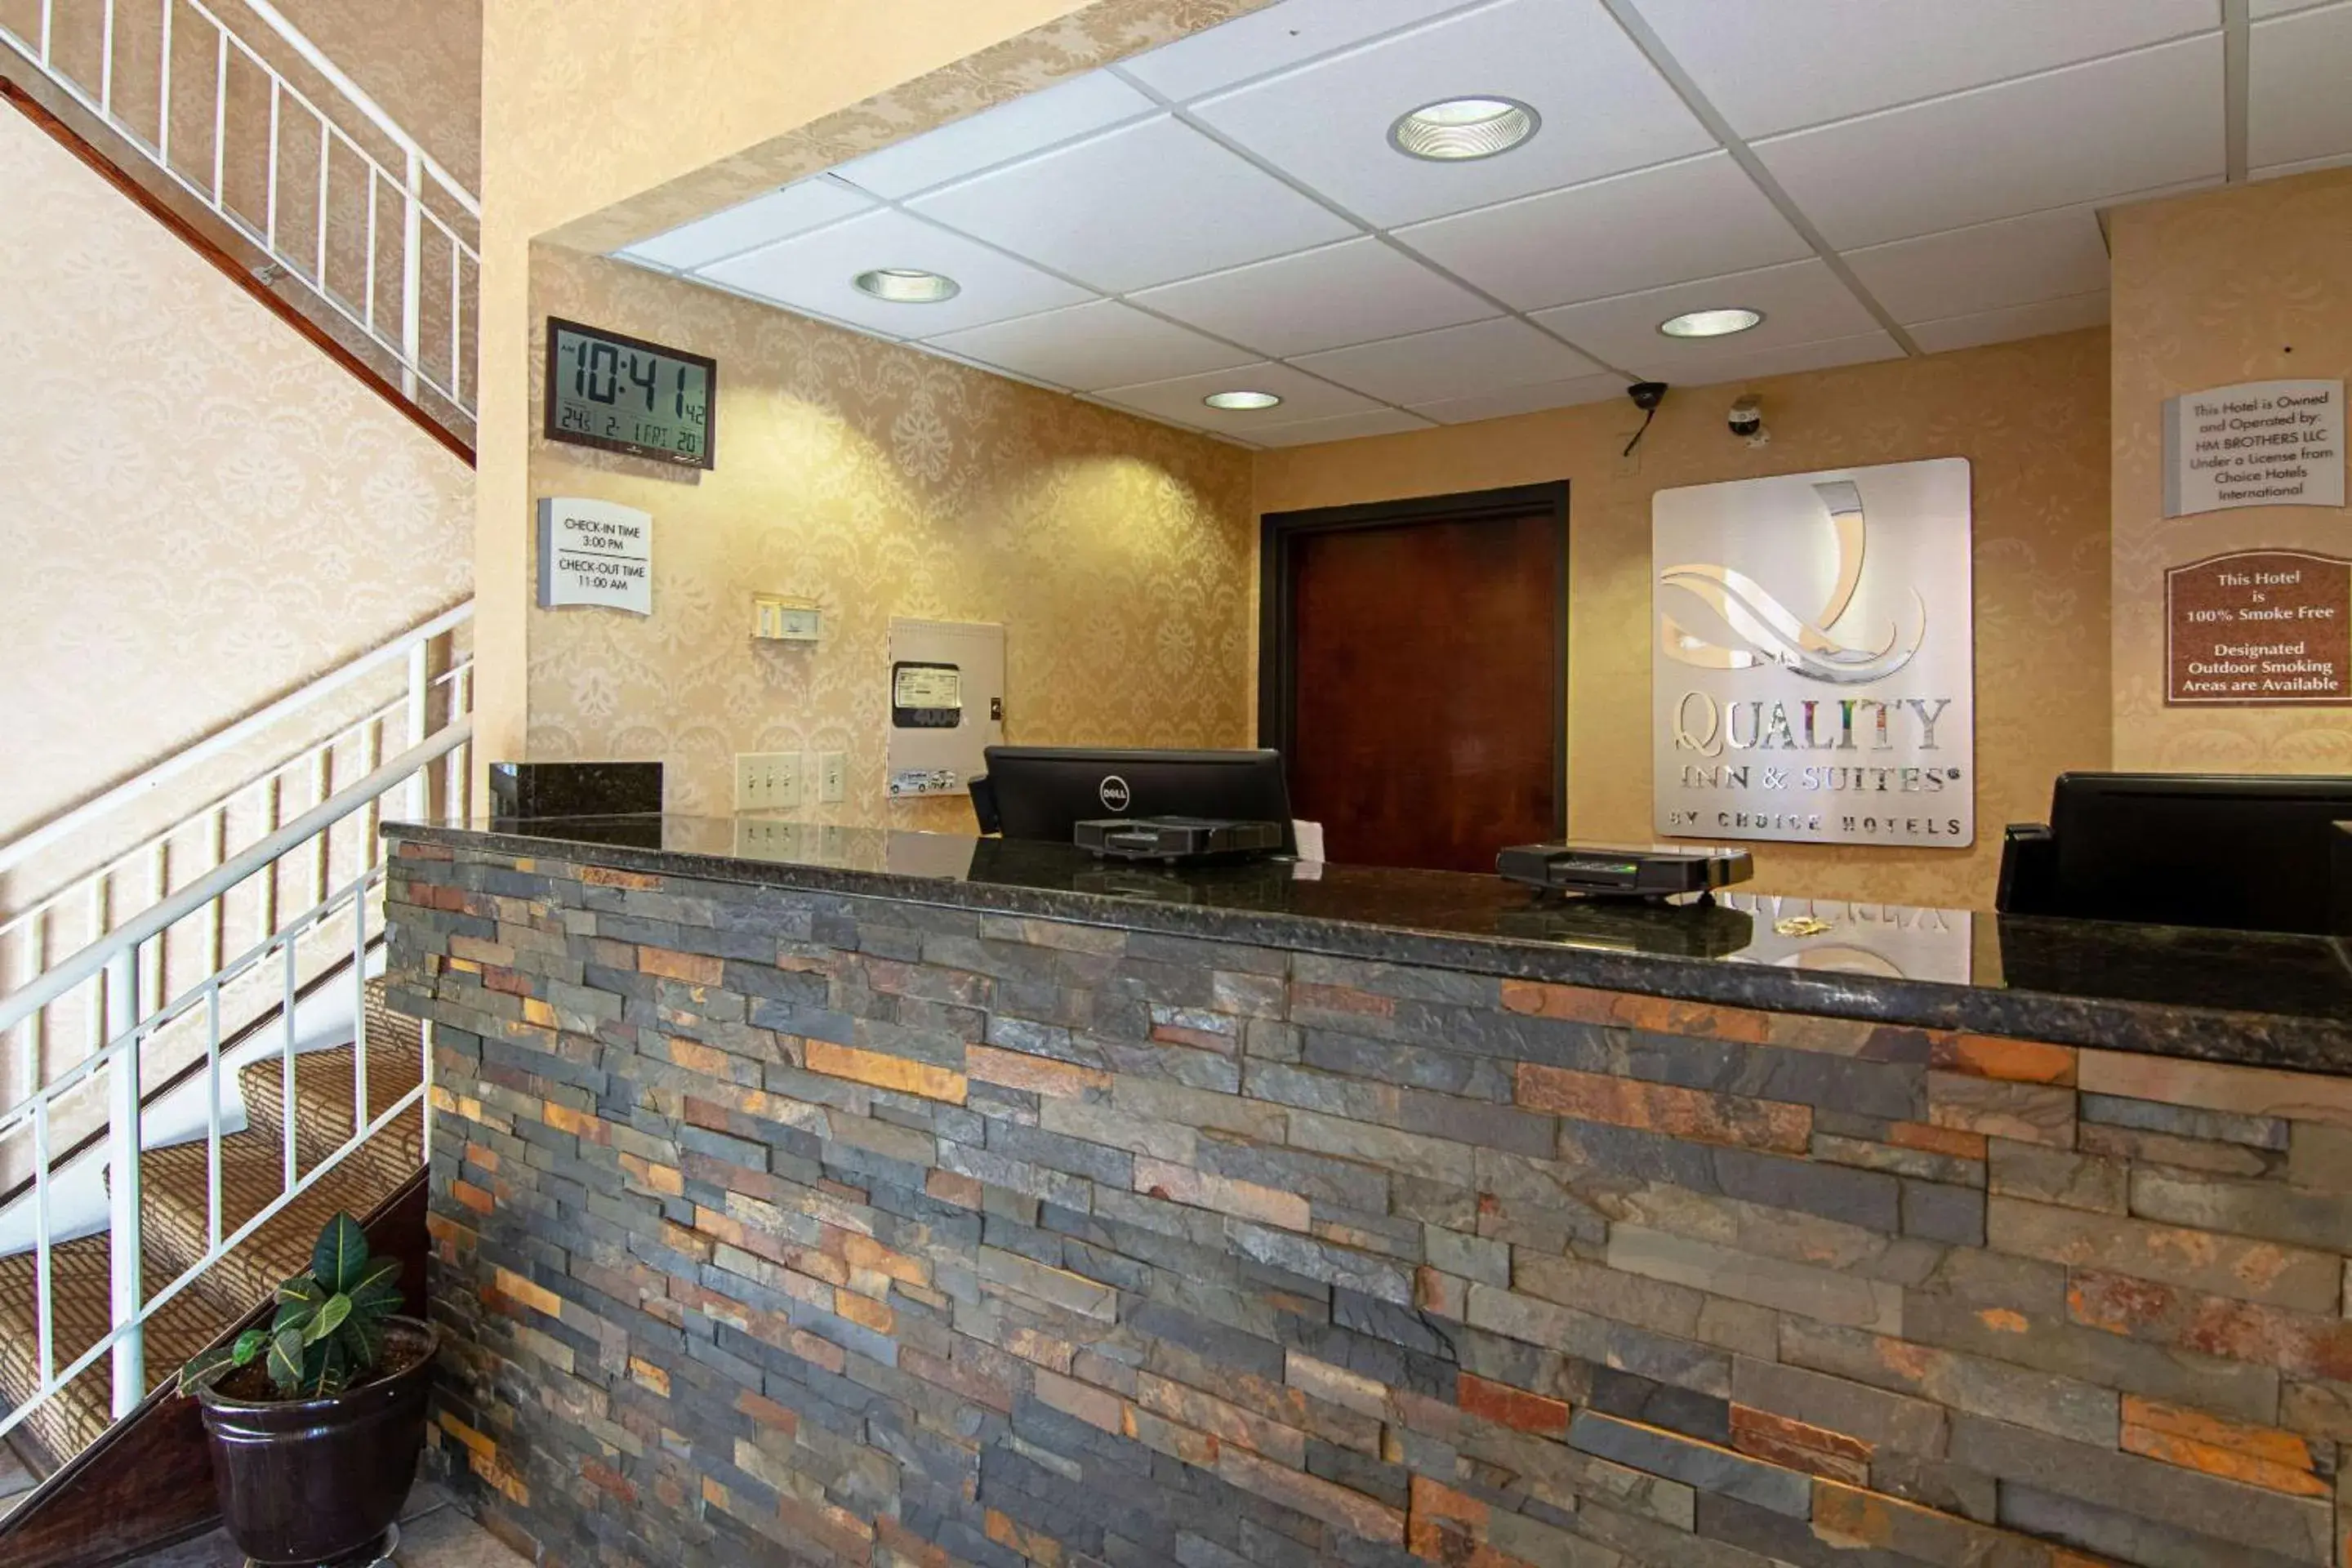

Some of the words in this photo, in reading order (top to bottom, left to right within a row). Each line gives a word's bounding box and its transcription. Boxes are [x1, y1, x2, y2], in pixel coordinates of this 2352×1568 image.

[576, 340, 685, 419] 10:41
[2194, 405, 2219, 417] This
[2222, 398, 2258, 414] Hotel
[2262, 399, 2273, 410] is
[2276, 391, 2329, 408] Owned
[2199, 420, 2226, 434] and
[2230, 412, 2295, 431] Operated
[2195, 440, 2220, 452] HM
[2224, 432, 2299, 450] BROTHERS
[2303, 429, 2327, 443] LLC
[2189, 455, 2231, 470] Under
[2234, 457, 2244, 466] a
[2248, 450, 2296, 465] License
[2301, 447, 2333, 461] from
[2214, 470, 2261, 484] Choice
[2265, 466, 2308, 479] Hotels
[2218, 483, 2303, 501] International
[564, 518, 615, 534] CHECK-IN
[618, 525, 641, 538] TIME
[582, 535, 606, 548] 3:00
[608, 538, 623, 550] PM
[559, 558, 619, 576] CHECK-OUT
[622, 565, 645, 577] TIME
[579, 575, 607, 588] 11:00
[610, 580, 628, 590] AM
[2217, 572, 2252, 586] This
[2256, 570, 2301, 585] Hotel
[2252, 590, 2266, 603] is
[2187, 609, 2234, 622] 100%
[2238, 606, 2293, 621] Smoke
[2297, 605, 2335, 619] Free
[2214, 641, 2305, 660] Designated
[2188, 661, 2258, 675] Outdoor
[2261, 659, 2333, 675] Smoking
[2182, 679, 2227, 692] Areas
[2231, 681, 2258, 691] are
[2261, 677, 2339, 691] Available
[1673, 690, 1952, 757] QUALITY
[1681, 765, 1752, 790] INN
[1762, 767, 1788, 791] &
[1103, 789, 1127, 800] DELL
[1669, 811, 1699, 826] BY
[1718, 812, 1822, 831] CHOICE
[1842, 816, 1961, 835] HOTELS
